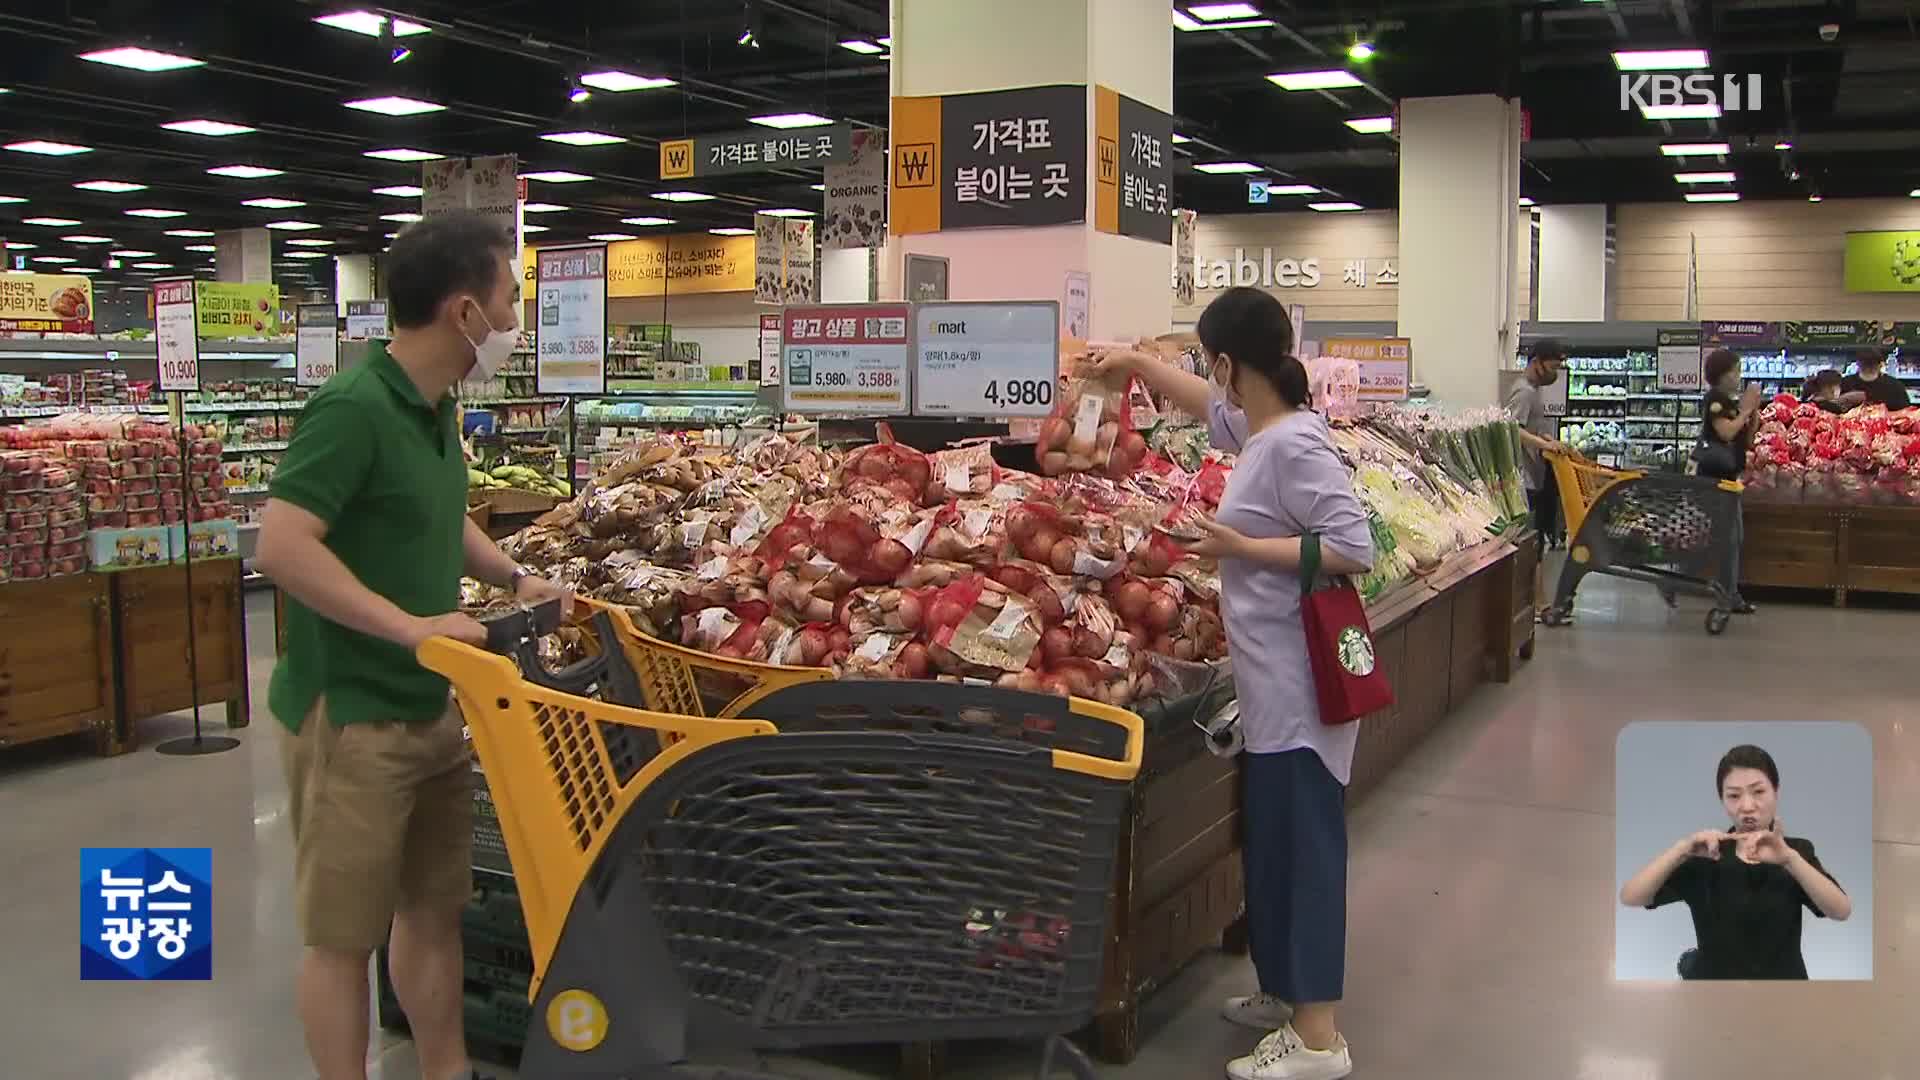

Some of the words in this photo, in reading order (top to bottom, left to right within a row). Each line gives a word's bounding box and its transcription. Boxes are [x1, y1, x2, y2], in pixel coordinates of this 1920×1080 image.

[971, 117, 1052, 155] 가격표
[710, 143, 759, 166] 가격표
[762, 138, 812, 162] 붙이는
[815, 135, 833, 158] 곳
[1130, 131, 1162, 169] 가격표
[954, 165, 1034, 202] 붙이는
[1041, 162, 1070, 199] 곳
[830, 185, 879, 198] ORGANIC
[1123, 171, 1154, 213] 붙이는
[1155, 183, 1168, 216] 곳
[757, 254, 782, 265] ORGANIC
[788, 259, 812, 269] ORGANIC
[638, 266, 663, 279] 스마트
[704, 262, 724, 276] 되는
[27, 297, 49, 312] 기준
[201, 312, 231, 325] 비비고
[233, 312, 252, 326] 김치
[791, 319, 822, 338] 광고
[825, 318, 857, 338] 상품
[929, 320, 967, 335] emart
[984, 379, 1052, 409] 4,980
